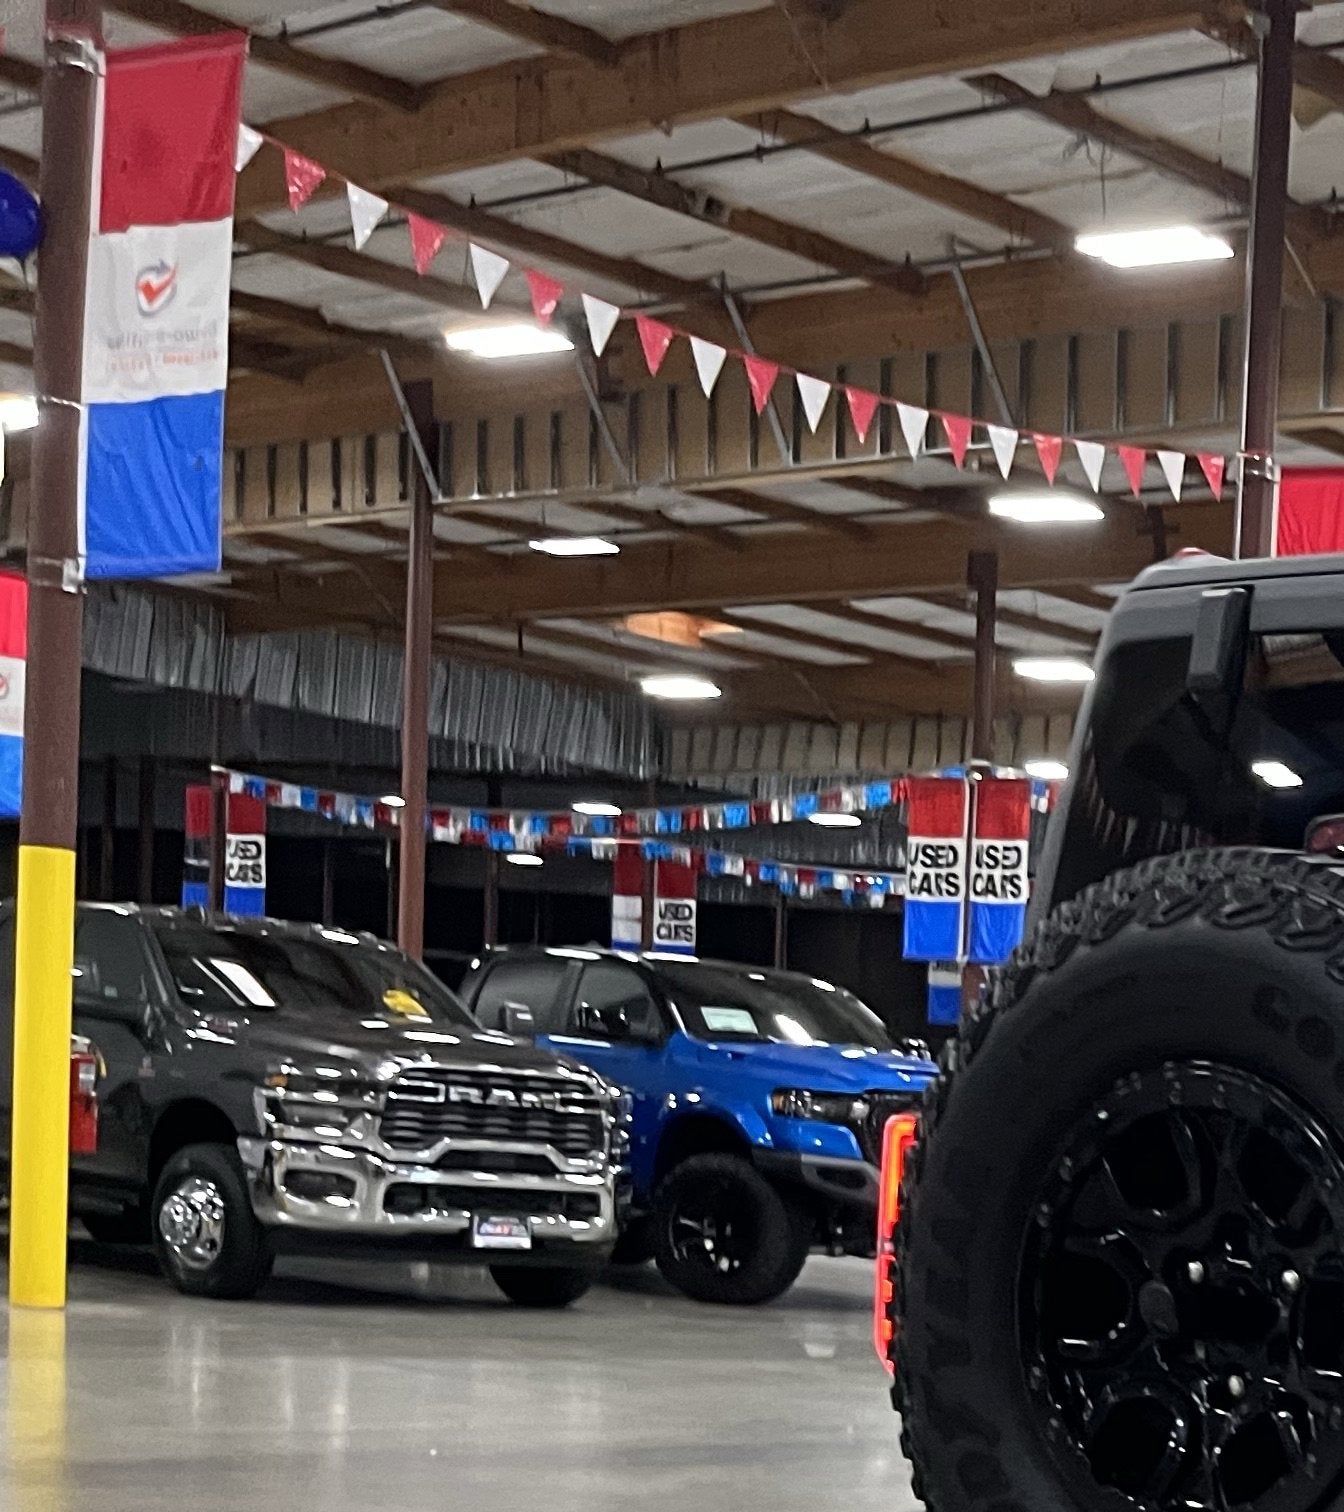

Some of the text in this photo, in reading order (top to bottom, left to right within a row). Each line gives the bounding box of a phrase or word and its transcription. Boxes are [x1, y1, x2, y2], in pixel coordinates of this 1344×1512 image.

[909, 842, 959, 869] USED
[976, 844, 1022, 870] USED
[908, 870, 961, 897] CARS
[972, 872, 1022, 899] CARS
[448, 1084, 565, 1113] RAM
